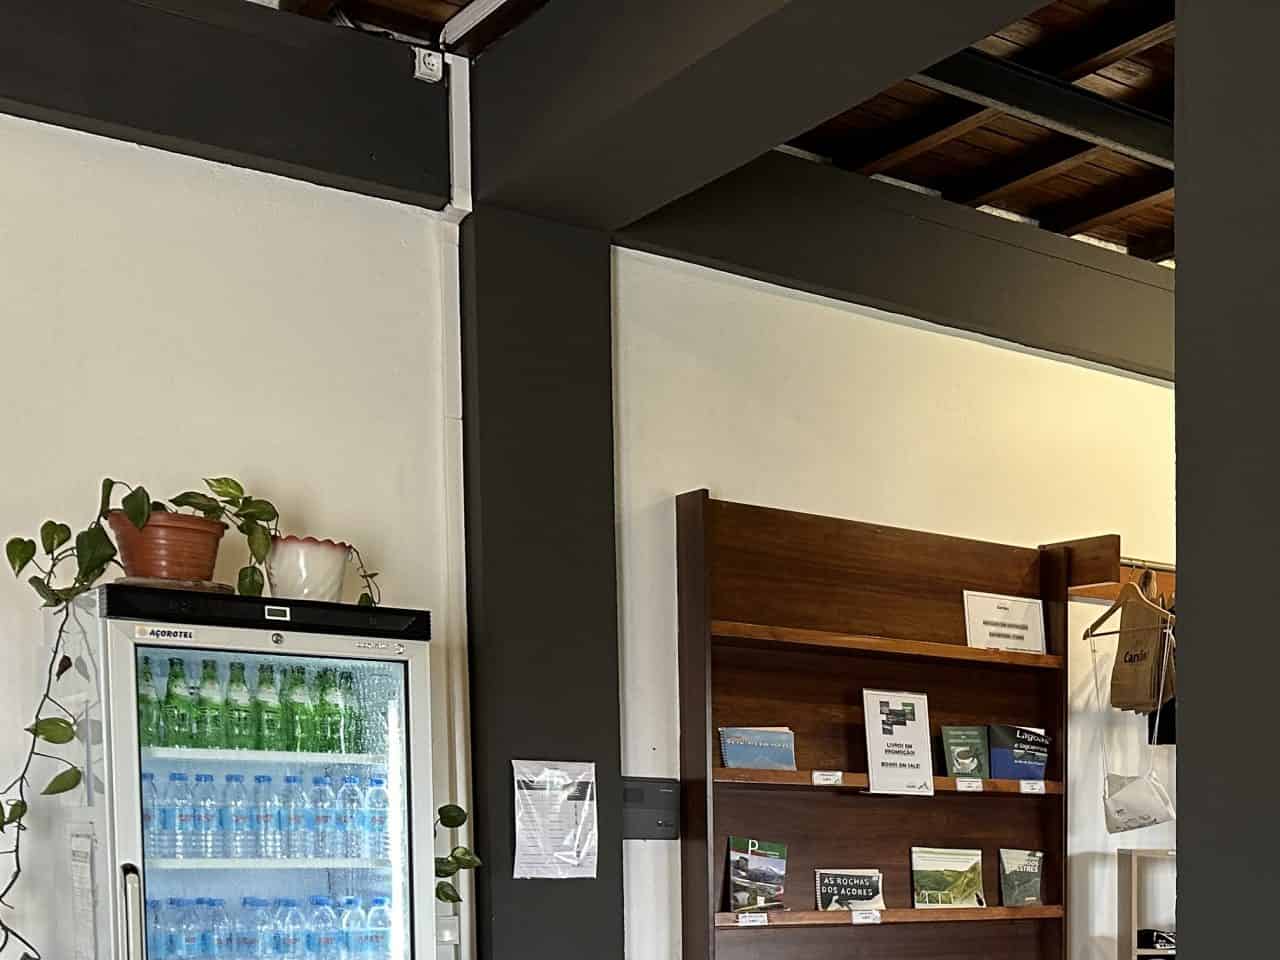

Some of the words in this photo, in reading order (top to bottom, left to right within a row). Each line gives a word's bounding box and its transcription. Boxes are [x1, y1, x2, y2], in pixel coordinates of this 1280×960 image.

[149, 629, 193, 639] AÇOROTEL
[824, 877, 835, 885] AS
[837, 878, 870, 887] ROCHAS
[821, 887, 838, 895] DOS
[840, 888, 873, 897] AÇORES
